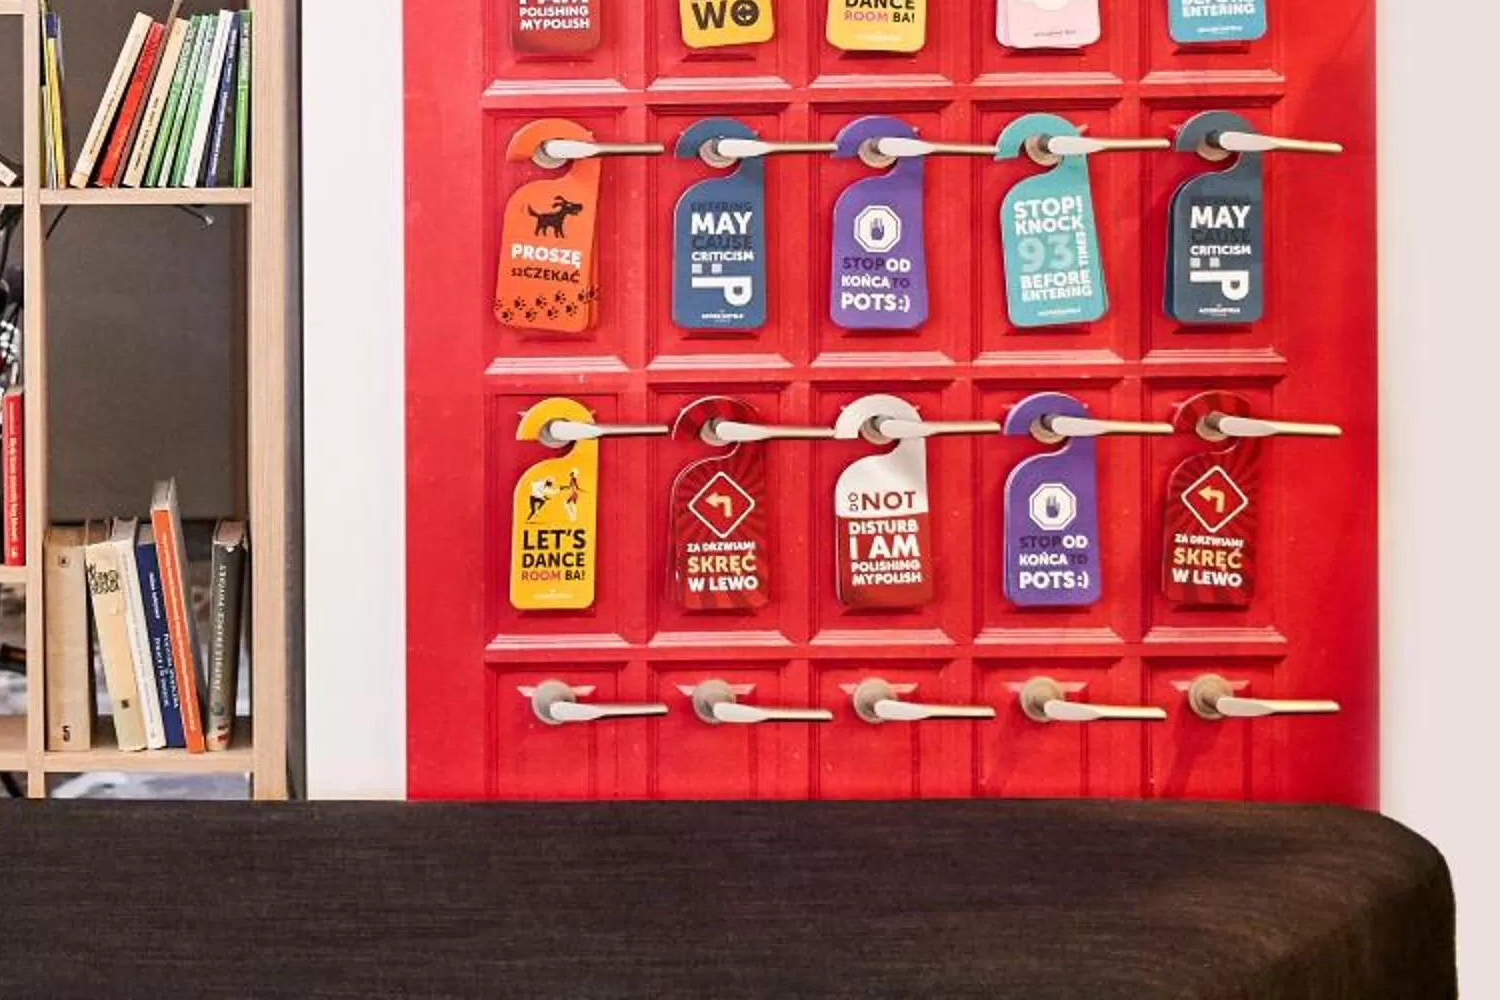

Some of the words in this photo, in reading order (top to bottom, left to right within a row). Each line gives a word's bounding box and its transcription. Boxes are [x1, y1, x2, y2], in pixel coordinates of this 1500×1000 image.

[519, 5, 590, 18] POLISHING
[844, 10, 889, 23] ROOM
[893, 11, 915, 24] BA!
[1181, 3, 1256, 18] ENTERING
[1013, 194, 1083, 220] STOP!
[691, 210, 753, 235] MAY
[1014, 214, 1085, 237] KNOCK
[1189, 204, 1251, 229] MAY
[691, 235, 753, 250] CAUSE
[1190, 229, 1251, 244] CAUSE
[510, 242, 581, 269] PROSZĘ
[691, 250, 755, 261] CRITICISM
[1017, 233, 1074, 273] 93
[1075, 231, 1089, 267] TIMES
[1189, 244, 1252, 255] CRITICISM
[842, 256, 885, 271] STOP
[885, 257, 912, 273] OD
[841, 272, 891, 289] KOŃCA
[891, 276, 911, 289] TO
[1020, 268, 1092, 289] BEFORE
[1021, 285, 1093, 302] ENTERING
[861, 490, 917, 511] NOT
[848, 518, 919, 536] DISTURB
[522, 528, 587, 551] LET'S
[849, 535, 859, 561] I
[868, 533, 921, 559] AM
[1018, 535, 1061, 549] STOP
[1062, 534, 1088, 549] OD
[521, 551, 586, 569] DANCE
[687, 551, 757, 575] SKRĘĆ
[851, 558, 922, 573] POLISHING
[1018, 551, 1069, 567] KOŃCA
[1070, 553, 1089, 565] TO
[1172, 546, 1243, 572] SKRĘĆ
[521, 569, 562, 581] ROOM
[564, 569, 586, 581] BA!
[688, 577, 708, 592] W
[709, 574, 759, 592] LEWO
[1171, 567, 1189, 583] W
[1192, 569, 1243, 588] LEWO
